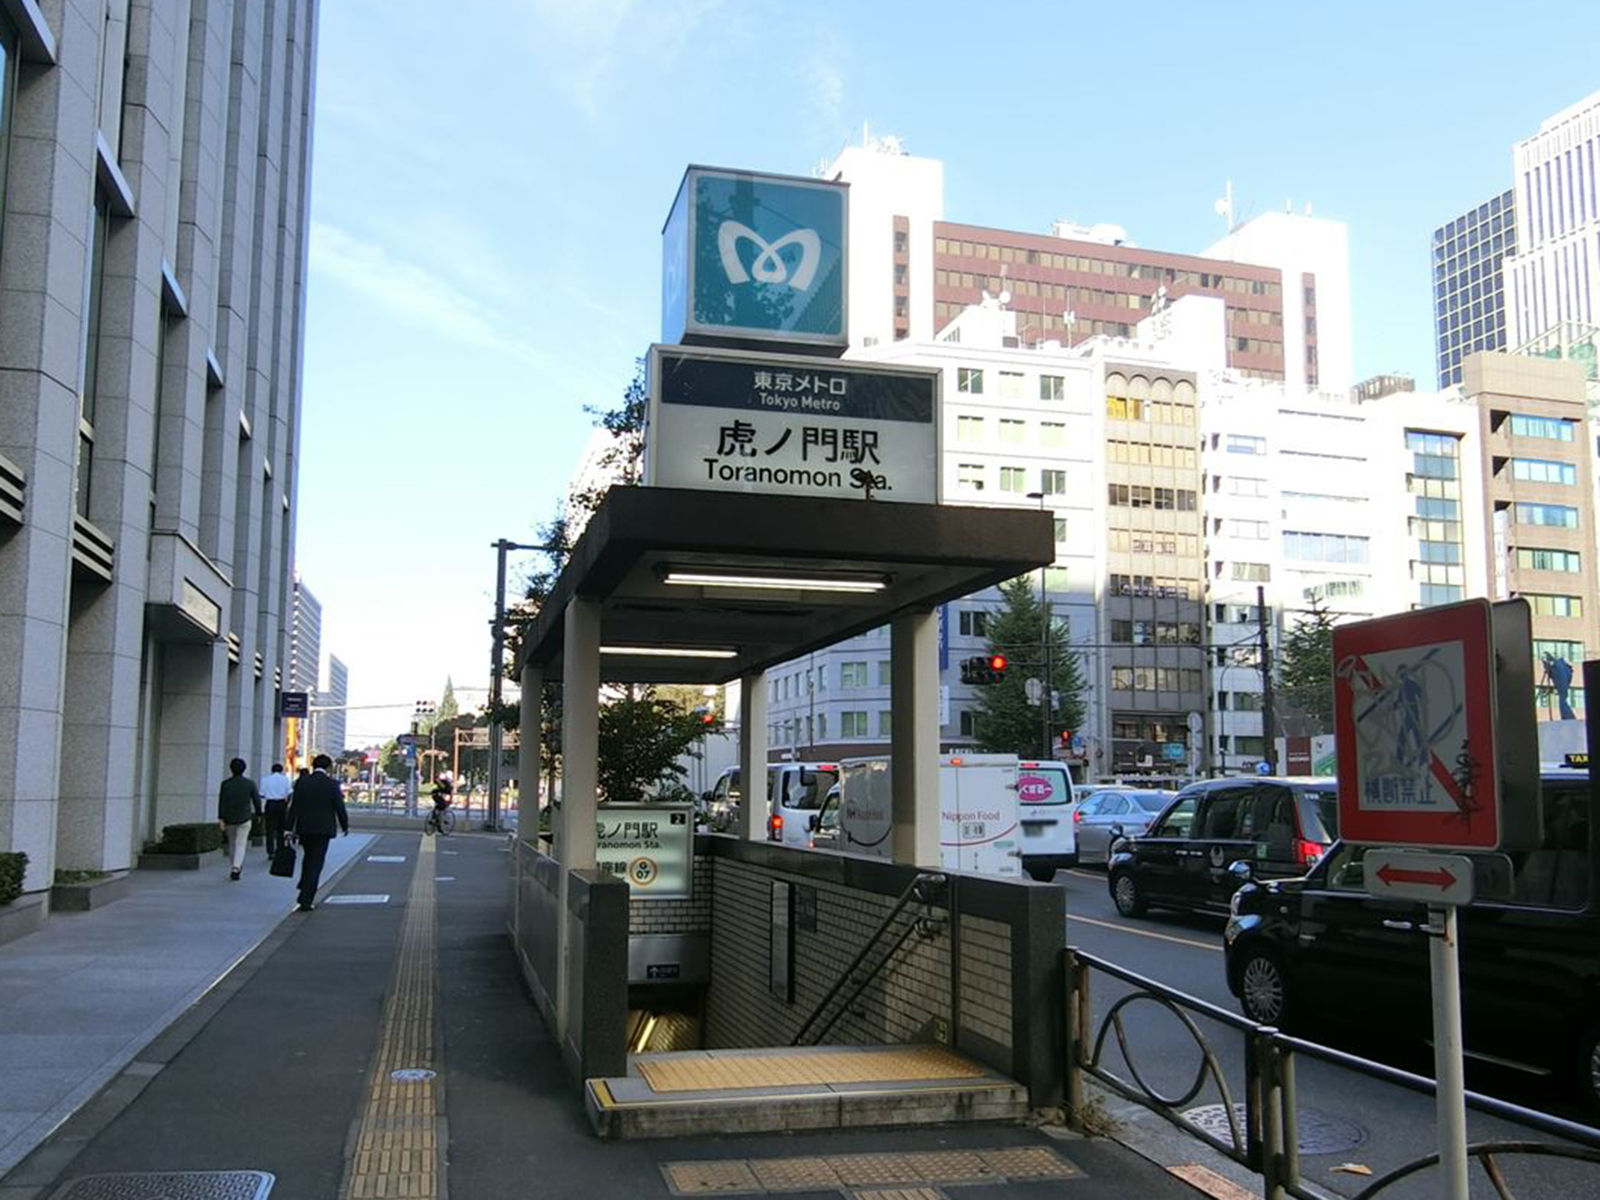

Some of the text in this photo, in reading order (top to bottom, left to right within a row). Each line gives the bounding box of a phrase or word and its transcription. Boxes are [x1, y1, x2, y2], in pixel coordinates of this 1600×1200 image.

[753, 371, 847, 395] 東京メトロ
[759, 393, 840, 411] Tokyo Metro
[716, 419, 880, 465] 虎ノ門駅
[703, 458, 893, 491] Toranomon Sta.
[1365, 777, 1437, 804] 横断禁止
[674, 814, 681, 824] 2
[942, 811, 1000, 823] Nippon Food
[597, 840, 662, 849] ranomon Sta.
[597, 861, 627, 874] 座線
[639, 861, 647, 870] G
[636, 870, 650, 879] 07
